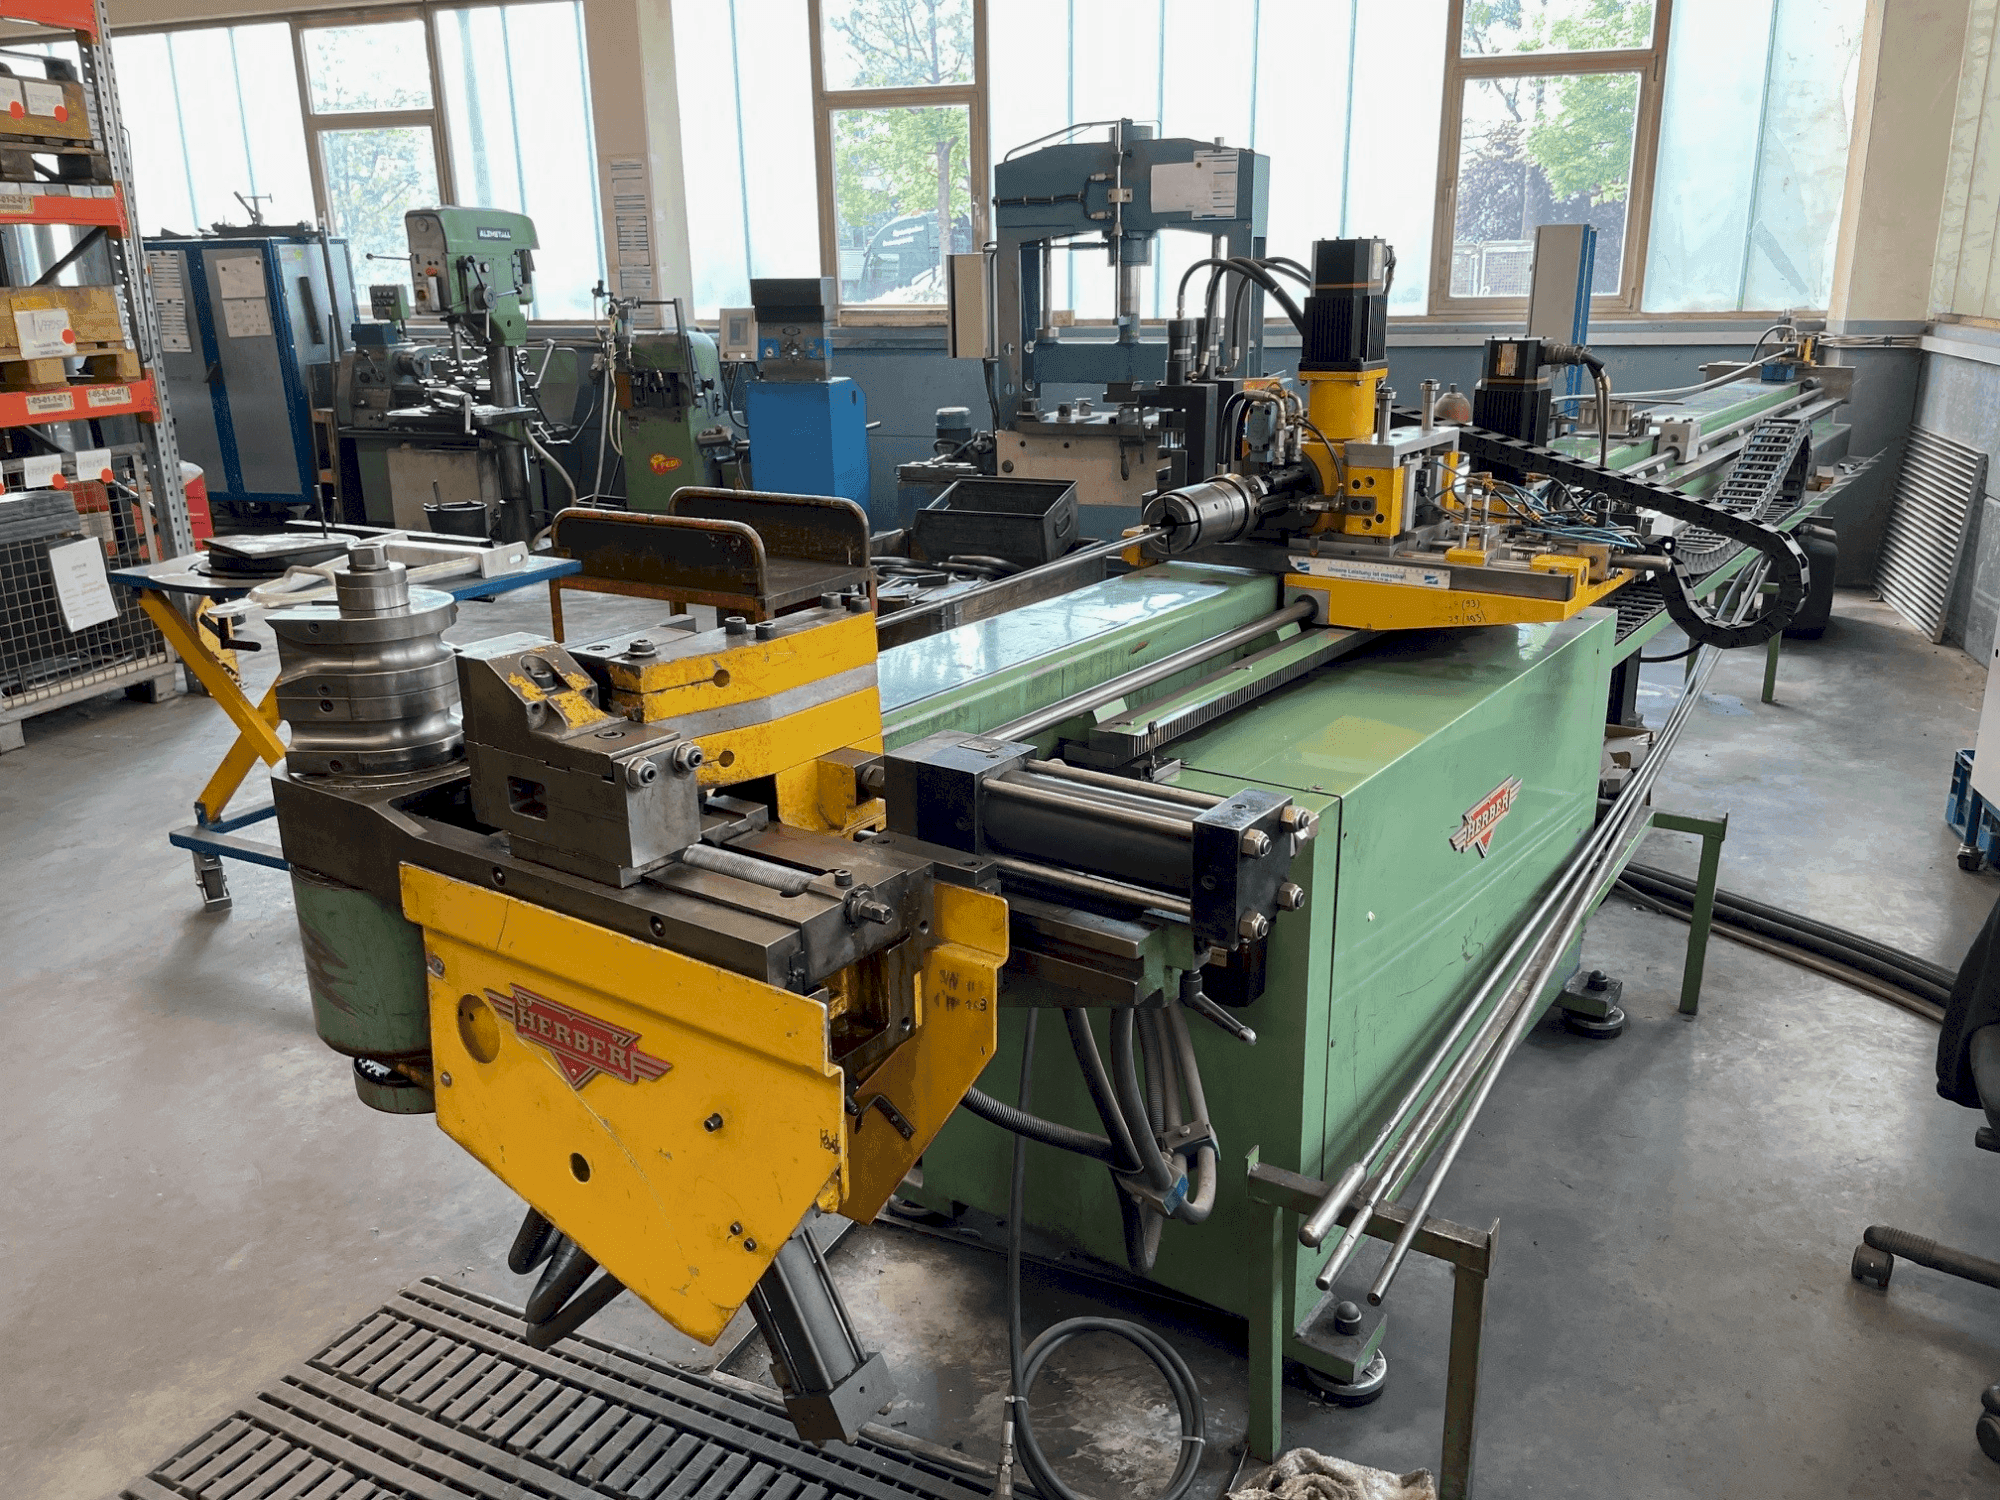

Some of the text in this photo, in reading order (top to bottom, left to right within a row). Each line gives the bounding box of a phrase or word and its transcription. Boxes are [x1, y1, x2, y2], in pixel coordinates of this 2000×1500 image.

[1327, 566, 1348, 574] Unsere
[1348, 568, 1372, 577] Leistung
[1465, 794, 1509, 843] HERBER
[516, 1005, 630, 1071] HERBER
